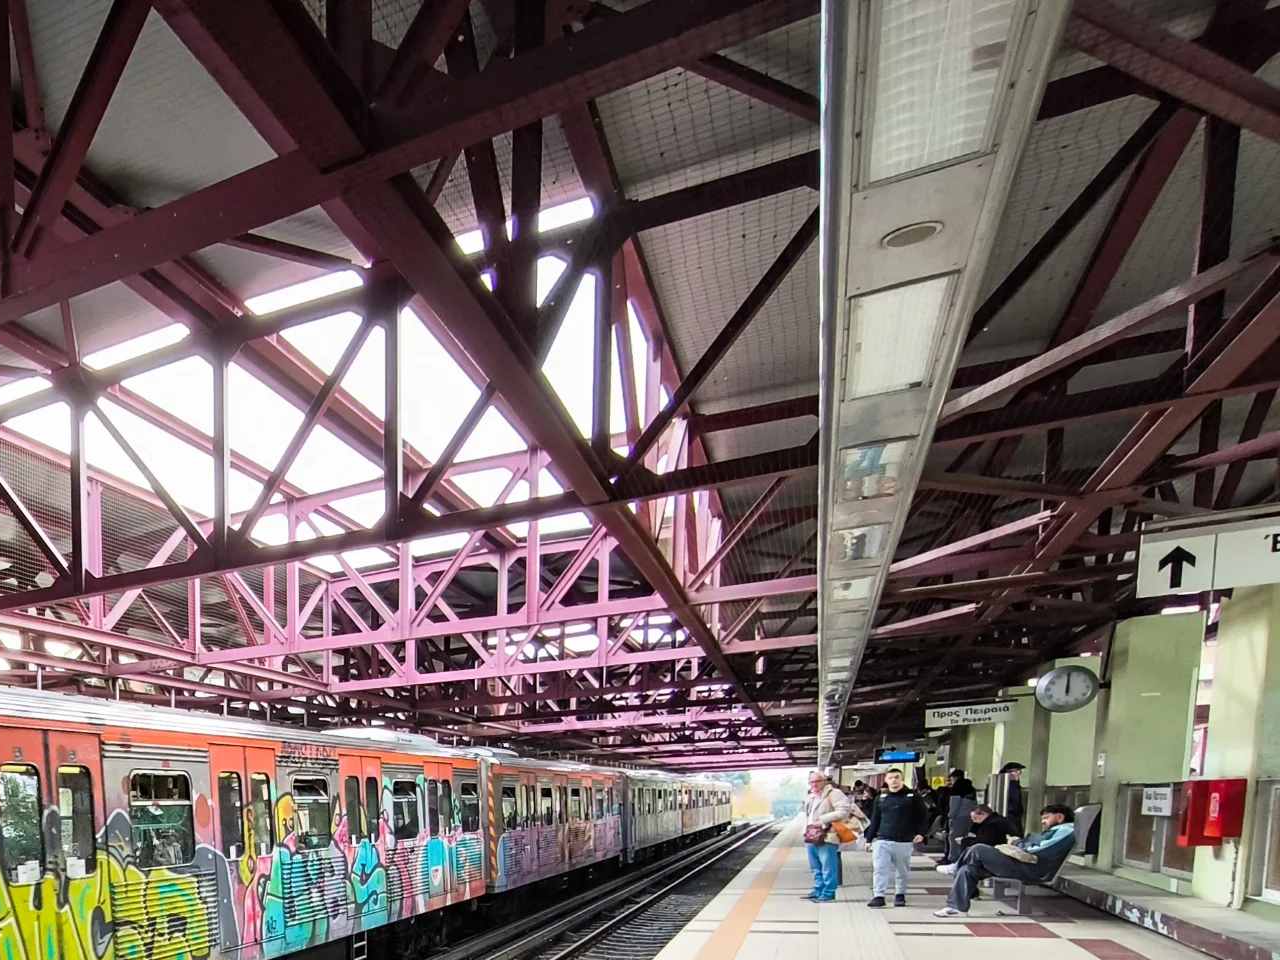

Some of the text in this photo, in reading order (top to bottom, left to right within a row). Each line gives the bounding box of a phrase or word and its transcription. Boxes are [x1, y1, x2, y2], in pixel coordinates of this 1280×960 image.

[932, 704, 1010, 719] Προς Πειραιά
[962, 716, 992, 724] Piraeus
